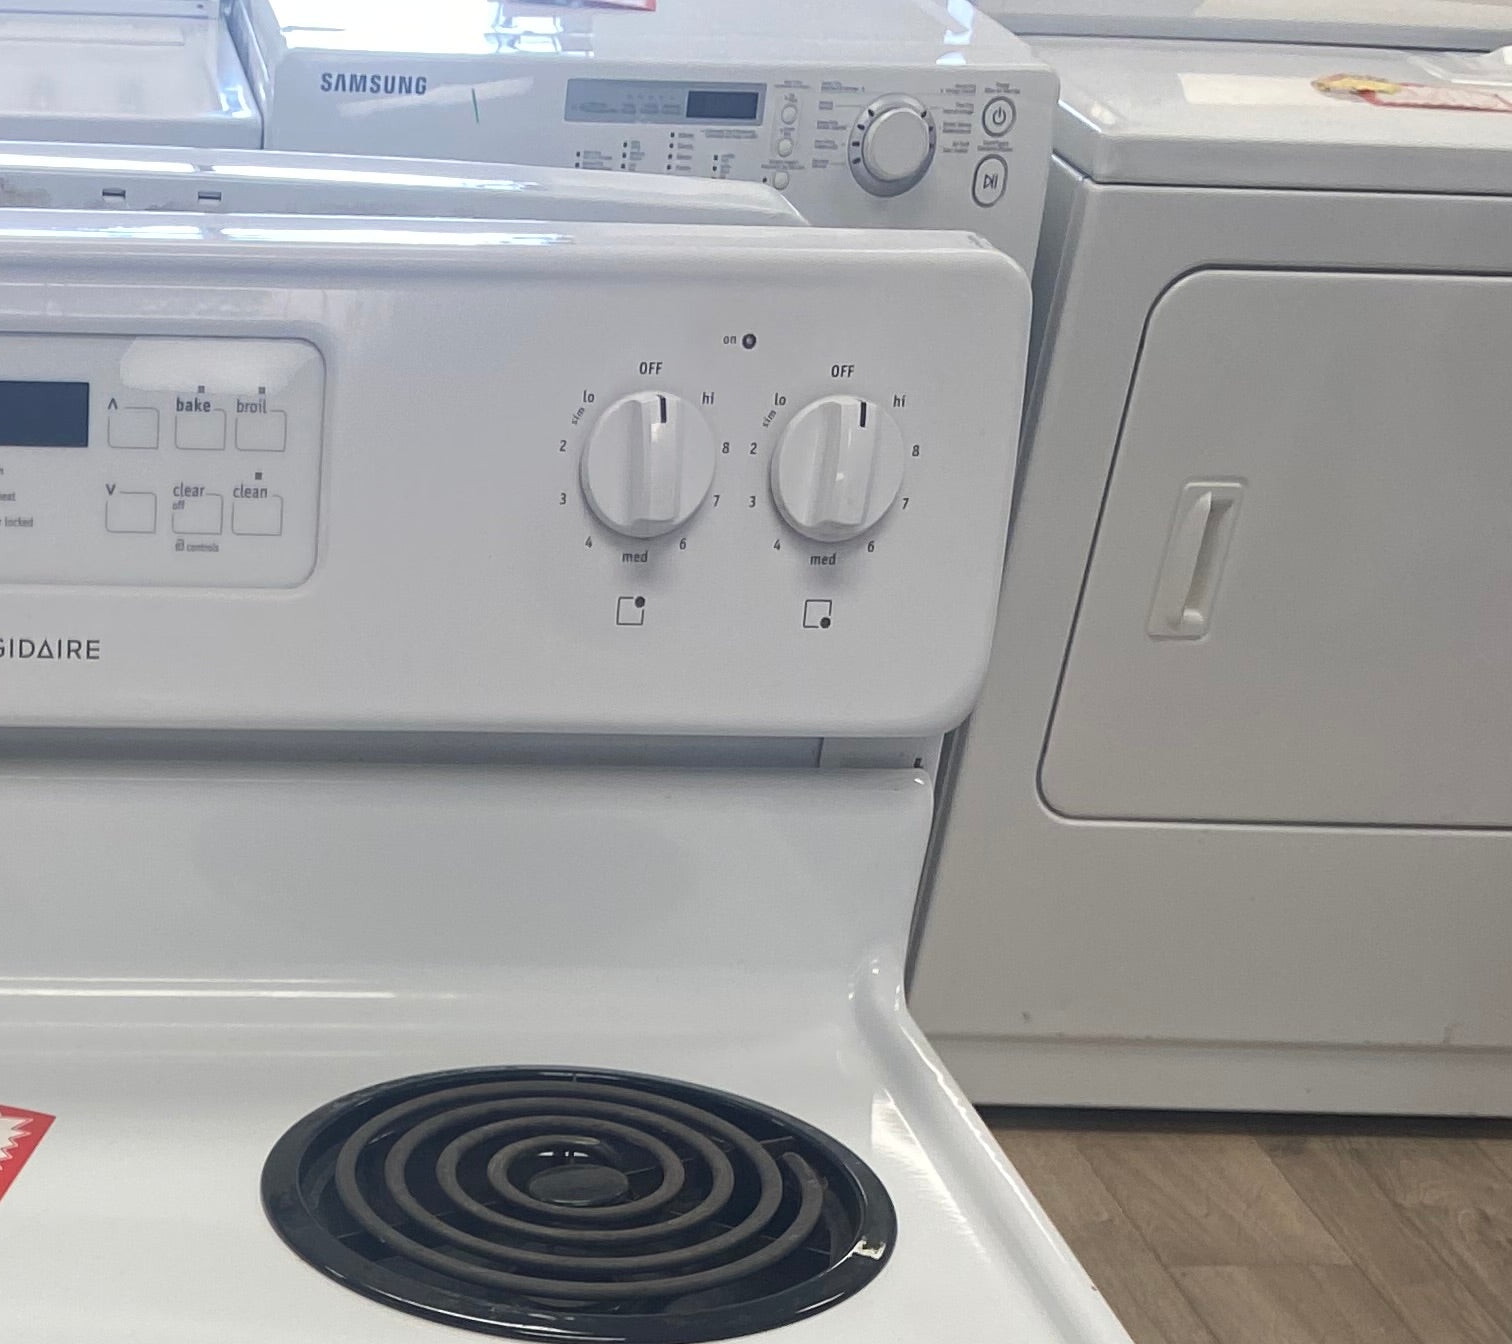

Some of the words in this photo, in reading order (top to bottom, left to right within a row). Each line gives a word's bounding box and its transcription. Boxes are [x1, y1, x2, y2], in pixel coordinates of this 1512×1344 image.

[320, 72, 427, 95] SAMSUNG
[722, 335, 737, 345] on
[639, 361, 663, 375] OFF
[831, 364, 855, 378] OFF
[582, 389, 595, 403] lo
[702, 391, 715, 405] hi
[774, 392, 787, 406] lo
[893, 394, 906, 408] hi
[175, 396, 212, 413] bake
[236, 398, 268, 415] broil
[559, 439, 567, 453] 2
[721, 441, 730, 454] 8
[749, 441, 758, 455] 2
[911, 444, 920, 457] 8
[172, 480, 206, 498] clear
[232, 482, 269, 500] clean
[171, 499, 186, 511] off
[559, 492, 567, 506] 3
[713, 494, 721, 507] 7
[748, 495, 756, 509] 3
[902, 497, 910, 510] 7
[584, 535, 593, 549] 4
[679, 536, 687, 550] 6
[773, 538, 781, 551] 4
[867, 539, 875, 553] 6
[622, 549, 649, 563] med
[810, 552, 837, 566] med
